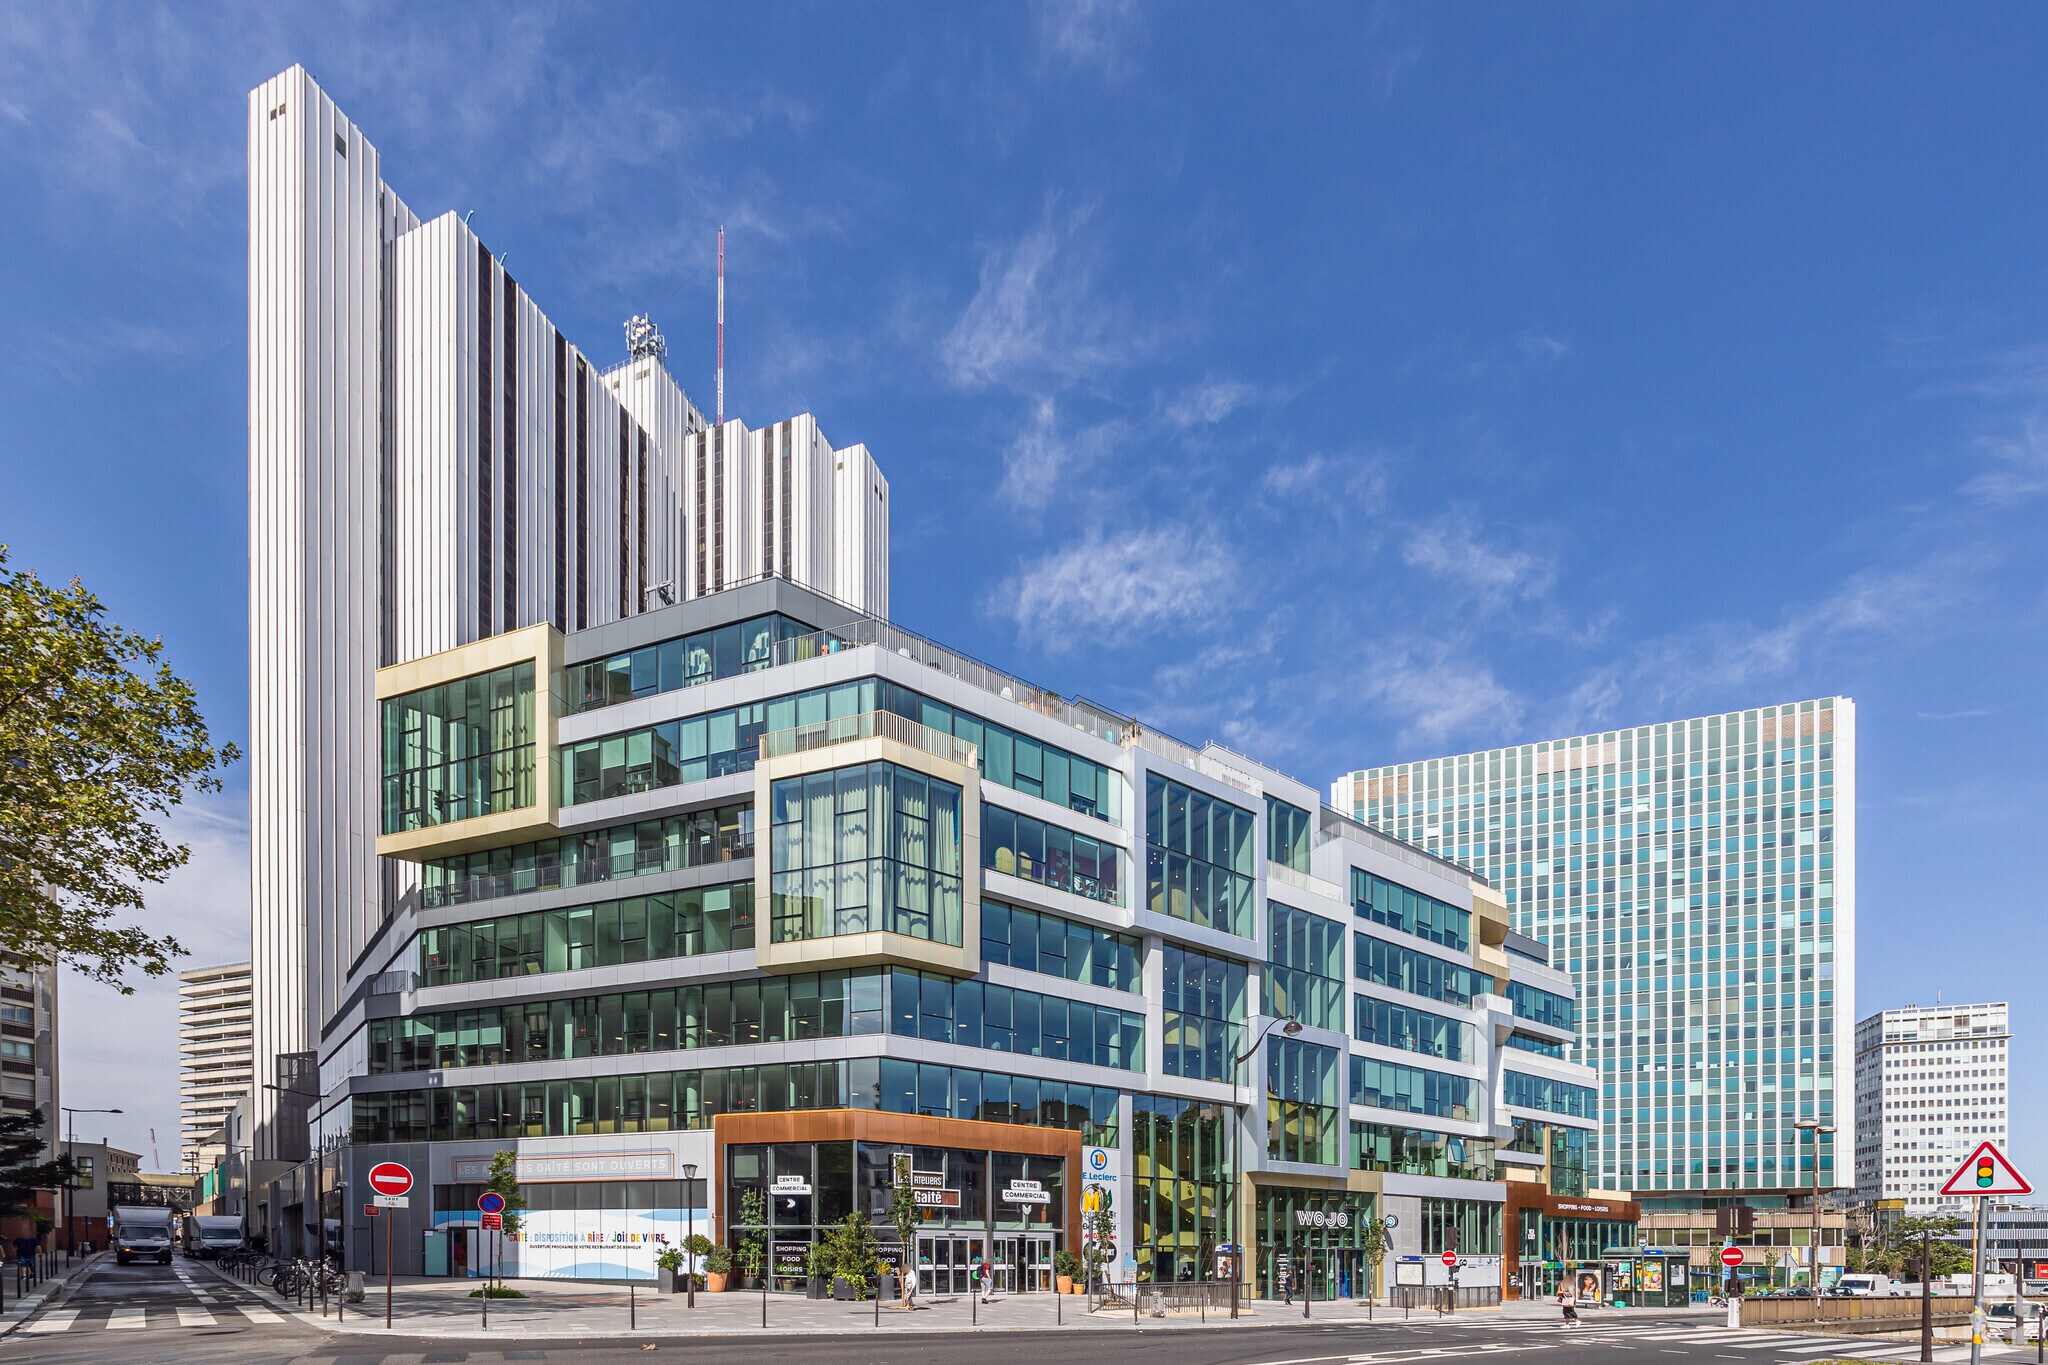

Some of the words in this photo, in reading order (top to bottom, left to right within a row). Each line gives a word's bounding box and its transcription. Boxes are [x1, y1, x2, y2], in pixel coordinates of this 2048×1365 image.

[458, 1165, 477, 1175] LES
[574, 1161, 605, 1172] SONT
[611, 1159, 666, 1171] OUVERTS
[914, 1175, 942, 1186] ATELIERS
[1083, 1191, 1099, 1213] M
[1297, 1210, 1348, 1227] WOJO
[630, 1234, 640, 1243] DE
